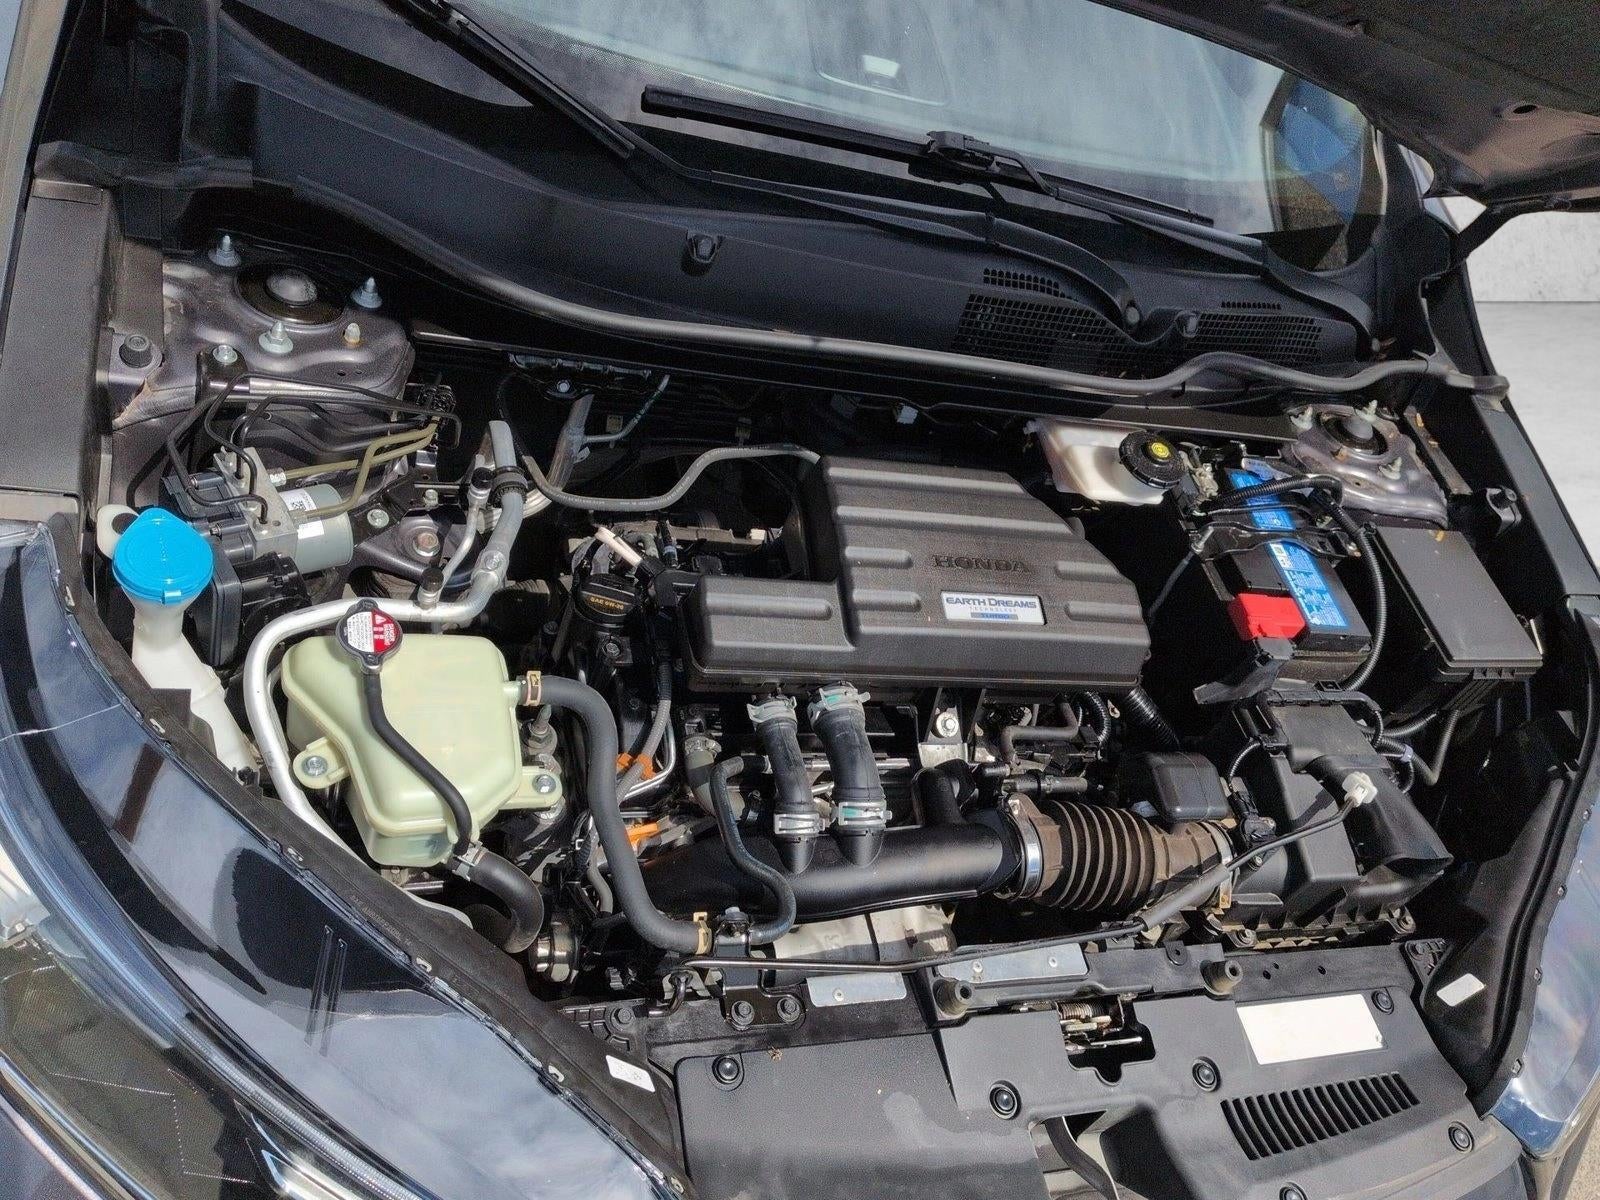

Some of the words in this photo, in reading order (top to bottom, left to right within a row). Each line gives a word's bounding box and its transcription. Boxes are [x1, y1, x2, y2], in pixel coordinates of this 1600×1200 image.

[932, 554, 1030, 573] HONDA
[946, 597, 986, 607] EARTH
[988, 598, 1037, 609] DREAMS
